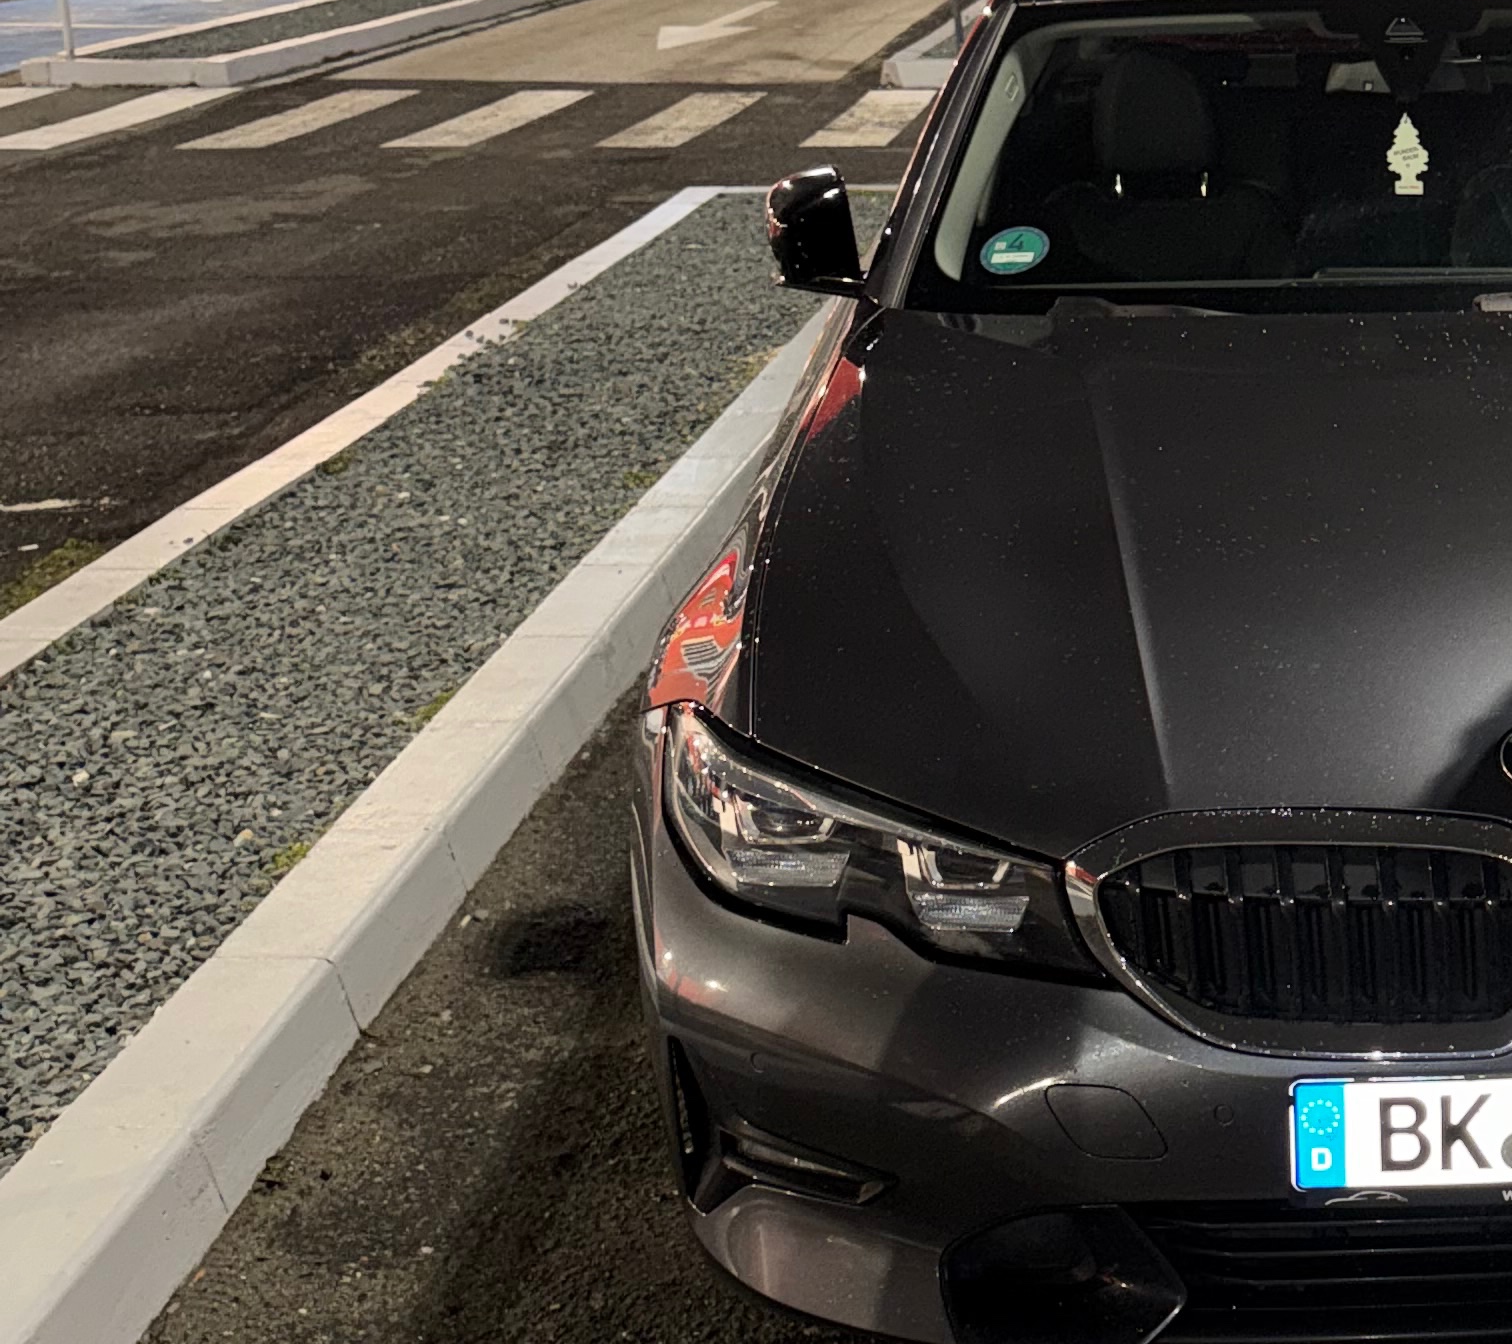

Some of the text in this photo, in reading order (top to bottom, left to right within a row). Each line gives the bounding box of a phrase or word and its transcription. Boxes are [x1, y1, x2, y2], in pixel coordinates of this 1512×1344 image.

[1007, 233, 1024, 251] 4
[1379, 1093, 1492, 1172] BK
[1311, 1147, 1333, 1172] D
